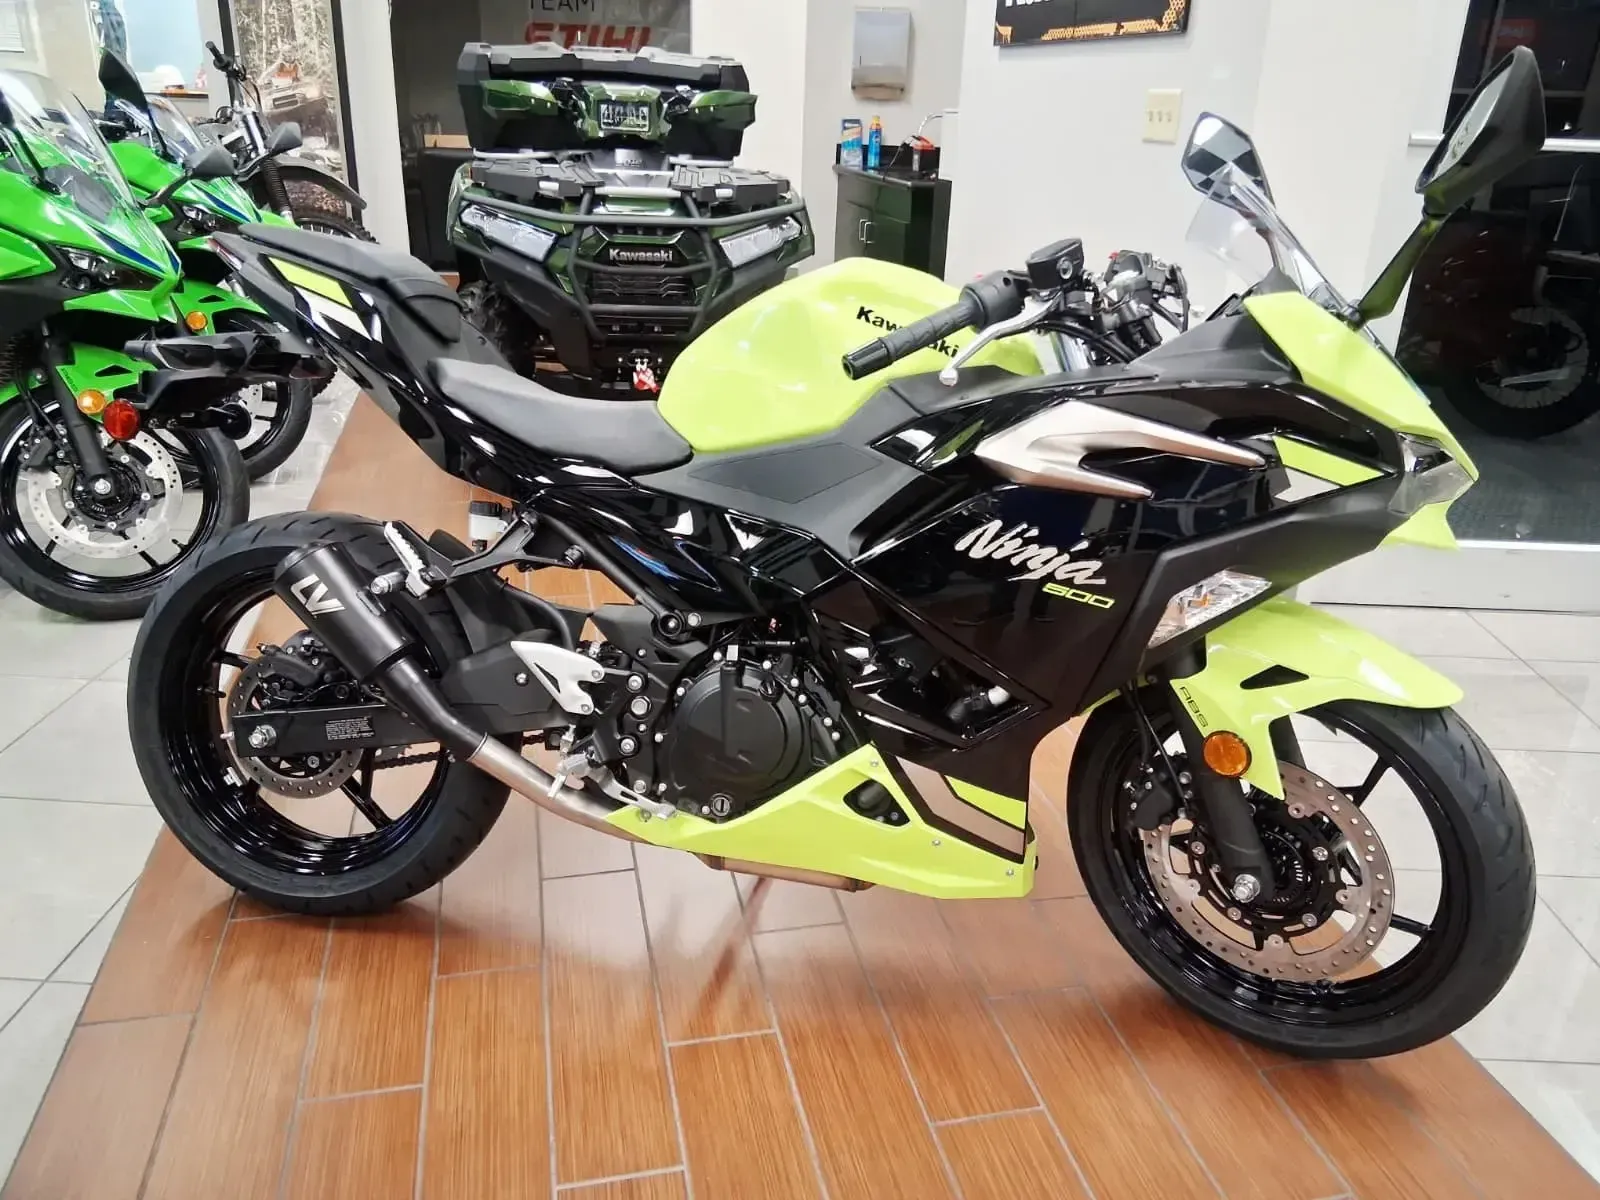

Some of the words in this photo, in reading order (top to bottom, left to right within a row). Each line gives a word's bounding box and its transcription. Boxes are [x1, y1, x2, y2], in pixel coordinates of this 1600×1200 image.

[609, 248, 673, 262] Kawasaki
[856, 305, 960, 358] Kawaki
[955, 519, 1107, 584] Ninja
[1179, 686, 1209, 728] ABS
